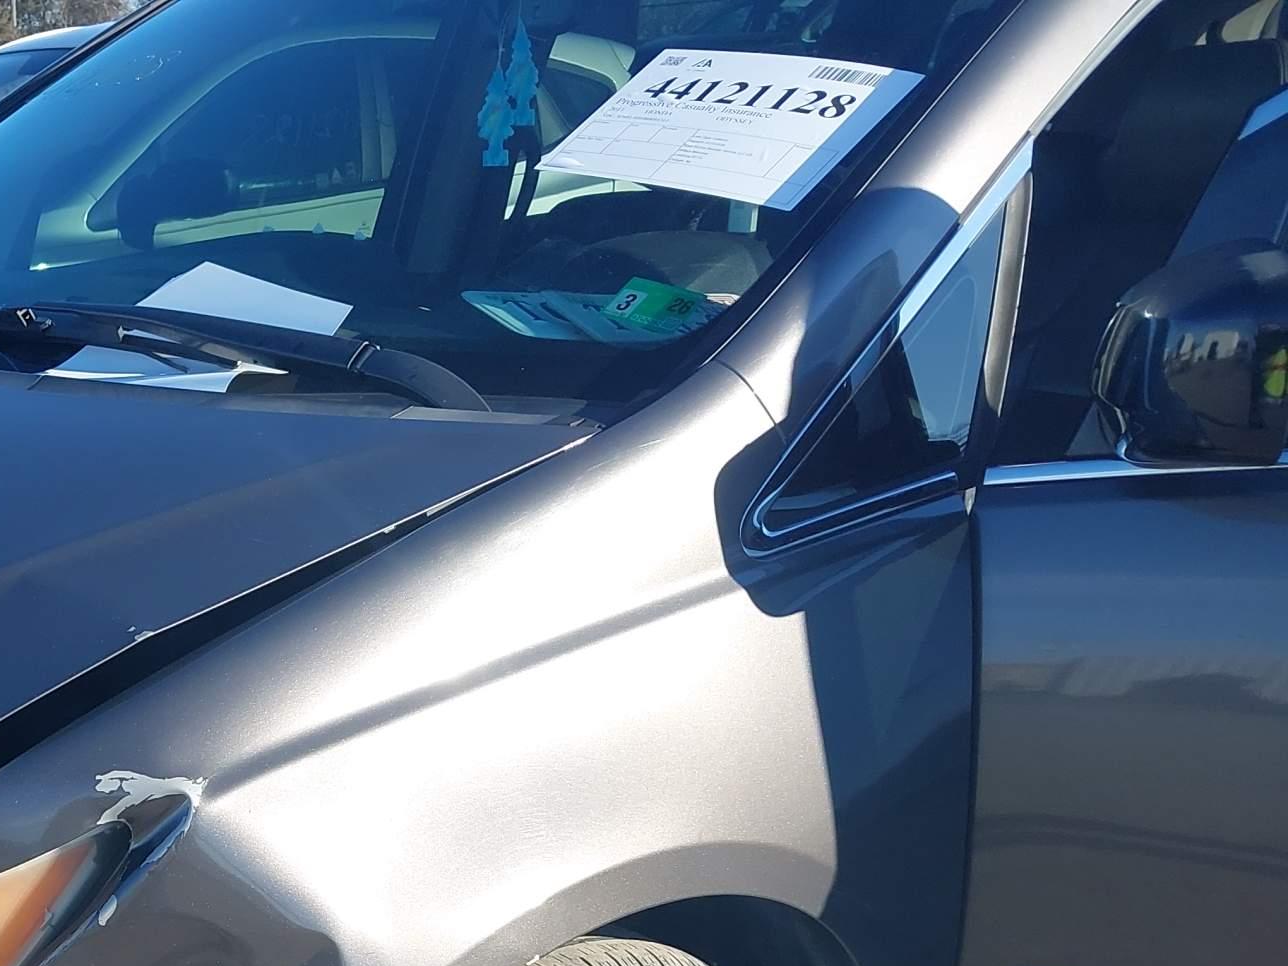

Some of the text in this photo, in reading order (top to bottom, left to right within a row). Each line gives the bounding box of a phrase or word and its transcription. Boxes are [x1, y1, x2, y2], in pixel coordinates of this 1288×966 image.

[615, 97, 773, 119] Progressive Casualty Insurance
[643, 76, 857, 119] 44121128
[616, 293, 638, 311] 3
